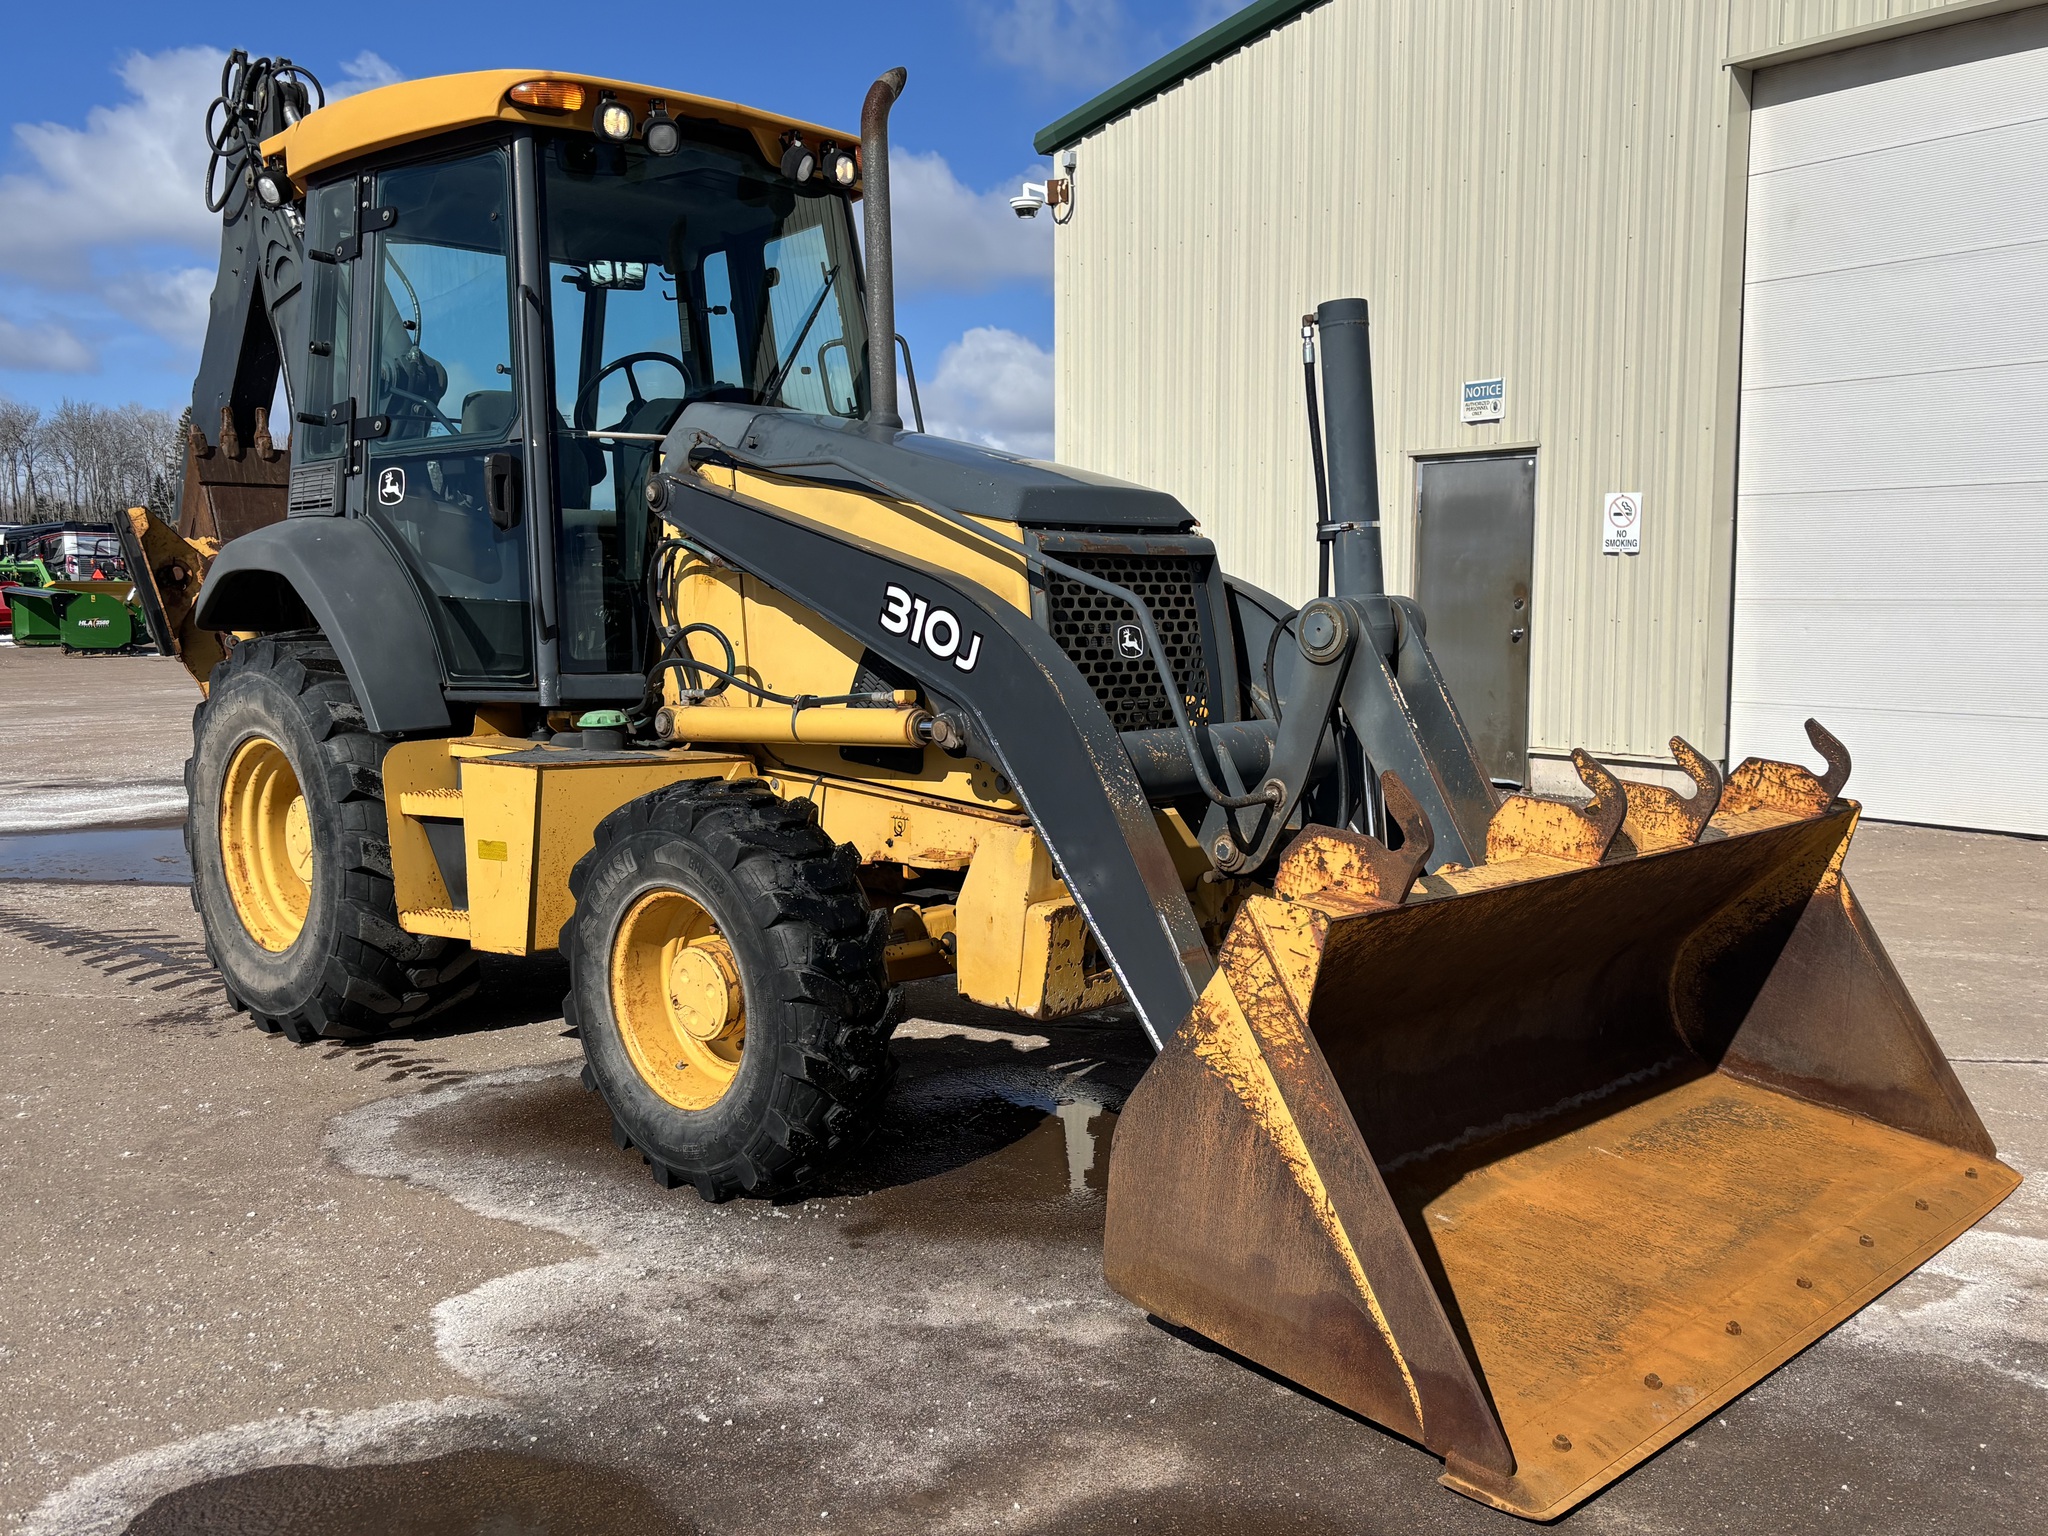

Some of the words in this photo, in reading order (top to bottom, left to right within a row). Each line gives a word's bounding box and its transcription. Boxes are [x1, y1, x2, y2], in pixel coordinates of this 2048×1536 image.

[1466, 384, 1502, 398] NOTICE
[1616, 530, 1627, 538] NO
[1605, 539, 1638, 548] SMOKING
[879, 584, 983, 672] 310J
[588, 848, 638, 913] CAMSO
